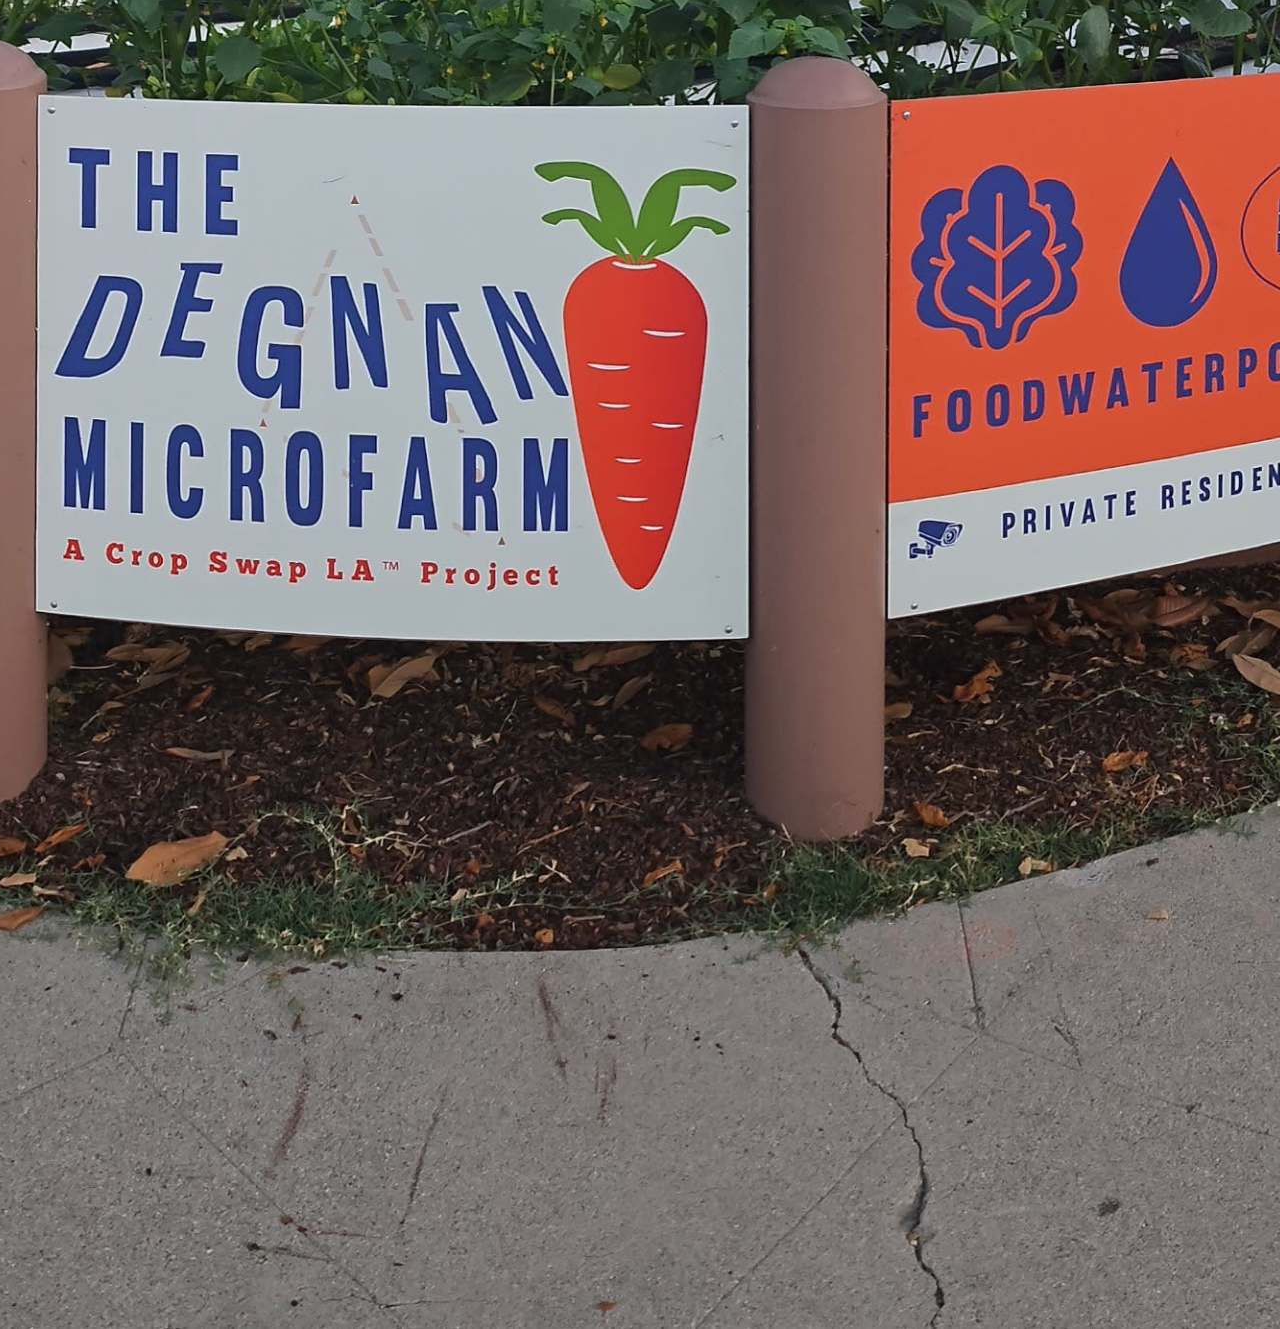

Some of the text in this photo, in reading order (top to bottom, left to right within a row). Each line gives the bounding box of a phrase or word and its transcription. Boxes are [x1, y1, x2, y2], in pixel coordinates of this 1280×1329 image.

[68, 147, 239, 236] THE
[54, 262, 570, 425] DEGNAN
[63, 416, 569, 532] MICROFARM
[1002, 490, 1137, 539] PRIVATE
[64, 538, 84, 561] A
[105, 542, 188, 575] Crop
[209, 551, 306, 584] Swap
[421, 562, 559, 591] Project
